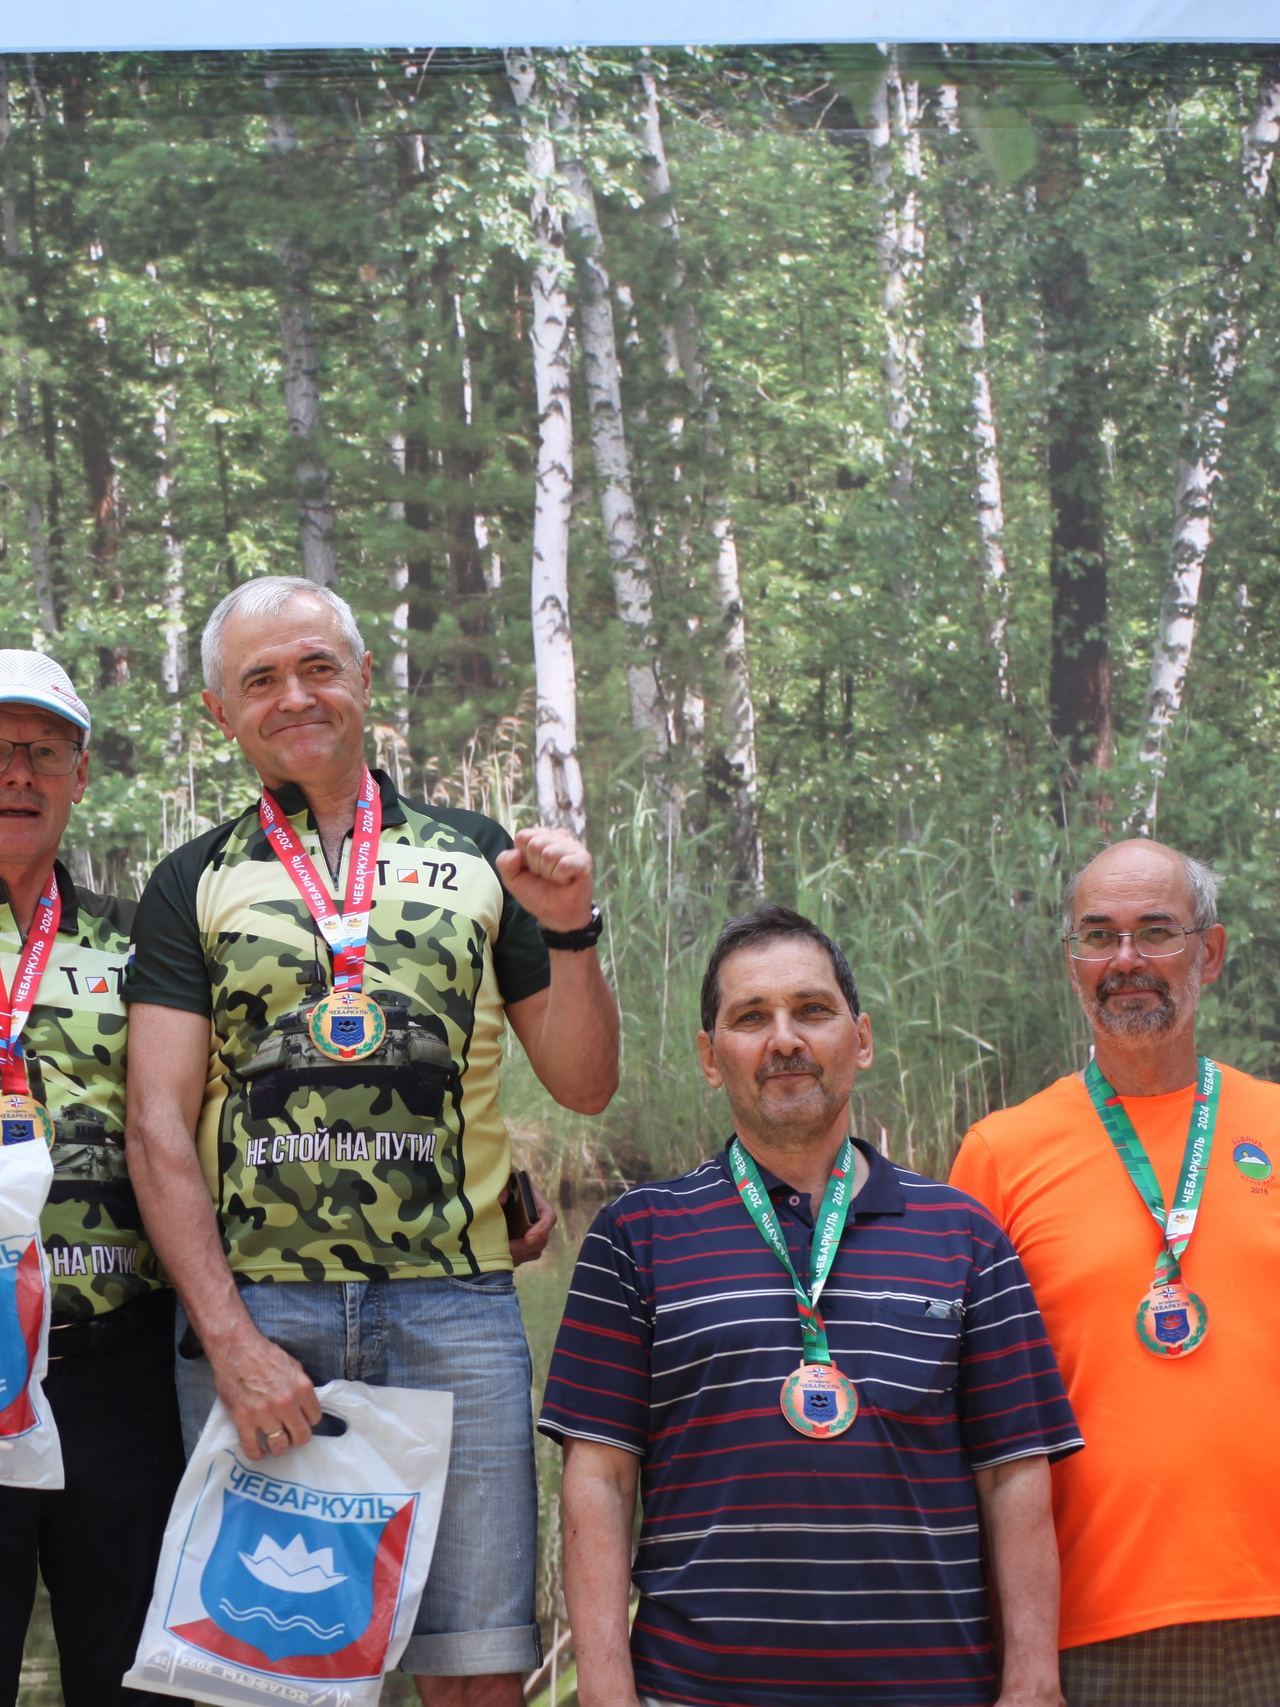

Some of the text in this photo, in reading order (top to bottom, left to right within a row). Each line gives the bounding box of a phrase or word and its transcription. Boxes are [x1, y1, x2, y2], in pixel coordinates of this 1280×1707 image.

[274, 827, 293, 850] 2024
[352, 840, 370, 905] ЧЕБАРКУЛЬ
[362, 809, 374, 833] 2024
[290, 853, 327, 914] ЧЕБАРКУЛЬ
[422, 862, 458, 891] 72
[15, 939, 45, 1003] ЧЕБАРКУЛЬ
[40, 908, 54, 933] 2024
[246, 1127, 436, 1167] НЕ СТОЙ НА ПУТИ!
[1182, 1136, 1205, 1203] ЧЕБАРКУЛЬ
[1197, 1105, 1210, 1130] 2024
[745, 1181, 762, 1208] 2024
[815, 1211, 839, 1277] ЧЕБАРКУЛЬ
[832, 1181, 846, 1206] 2024
[54, 1245, 138, 1277] НА ПУТИ!
[229, 1465, 396, 1519] ЧЕБАРКУЛЬ
[178, 1656, 213, 1674] 2024
